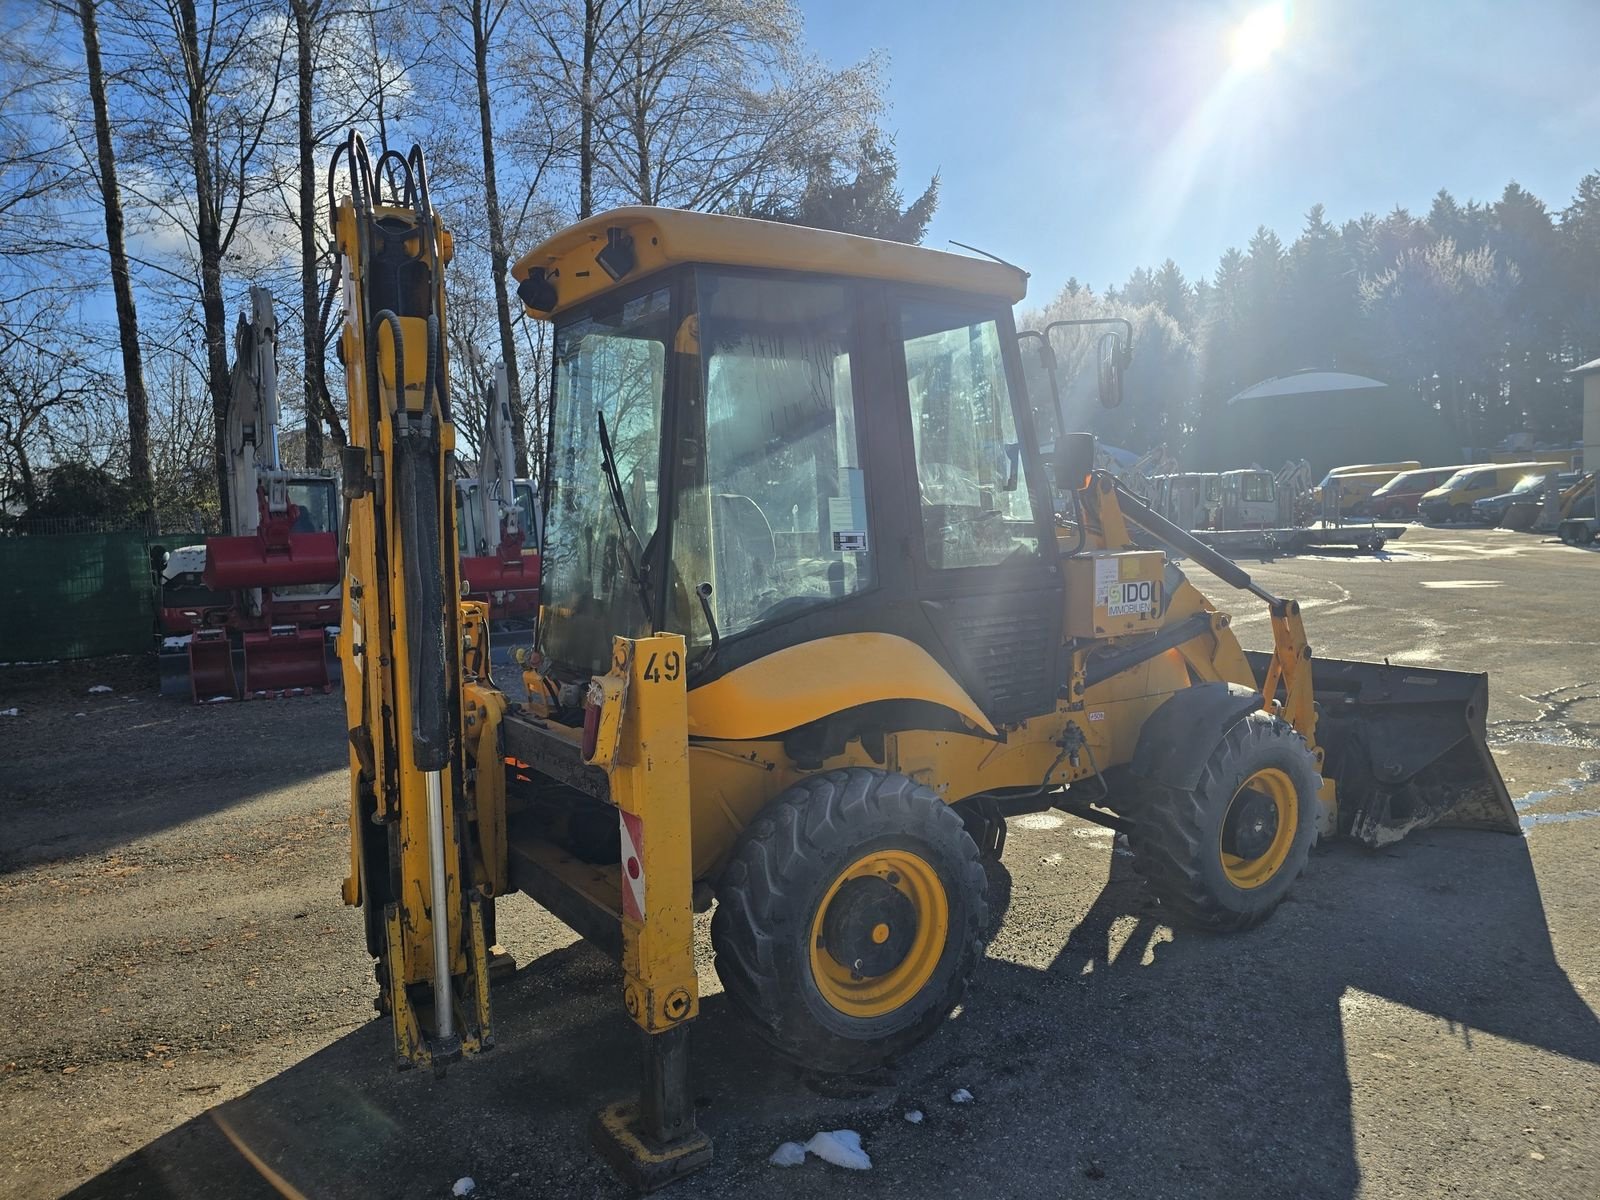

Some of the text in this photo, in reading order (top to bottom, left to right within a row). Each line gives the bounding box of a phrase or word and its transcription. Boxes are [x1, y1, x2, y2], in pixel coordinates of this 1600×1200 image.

[1108, 582, 1151, 604] SIDO
[1109, 603, 1150, 615] IMMOBILIEN
[643, 651, 680, 683] 49
